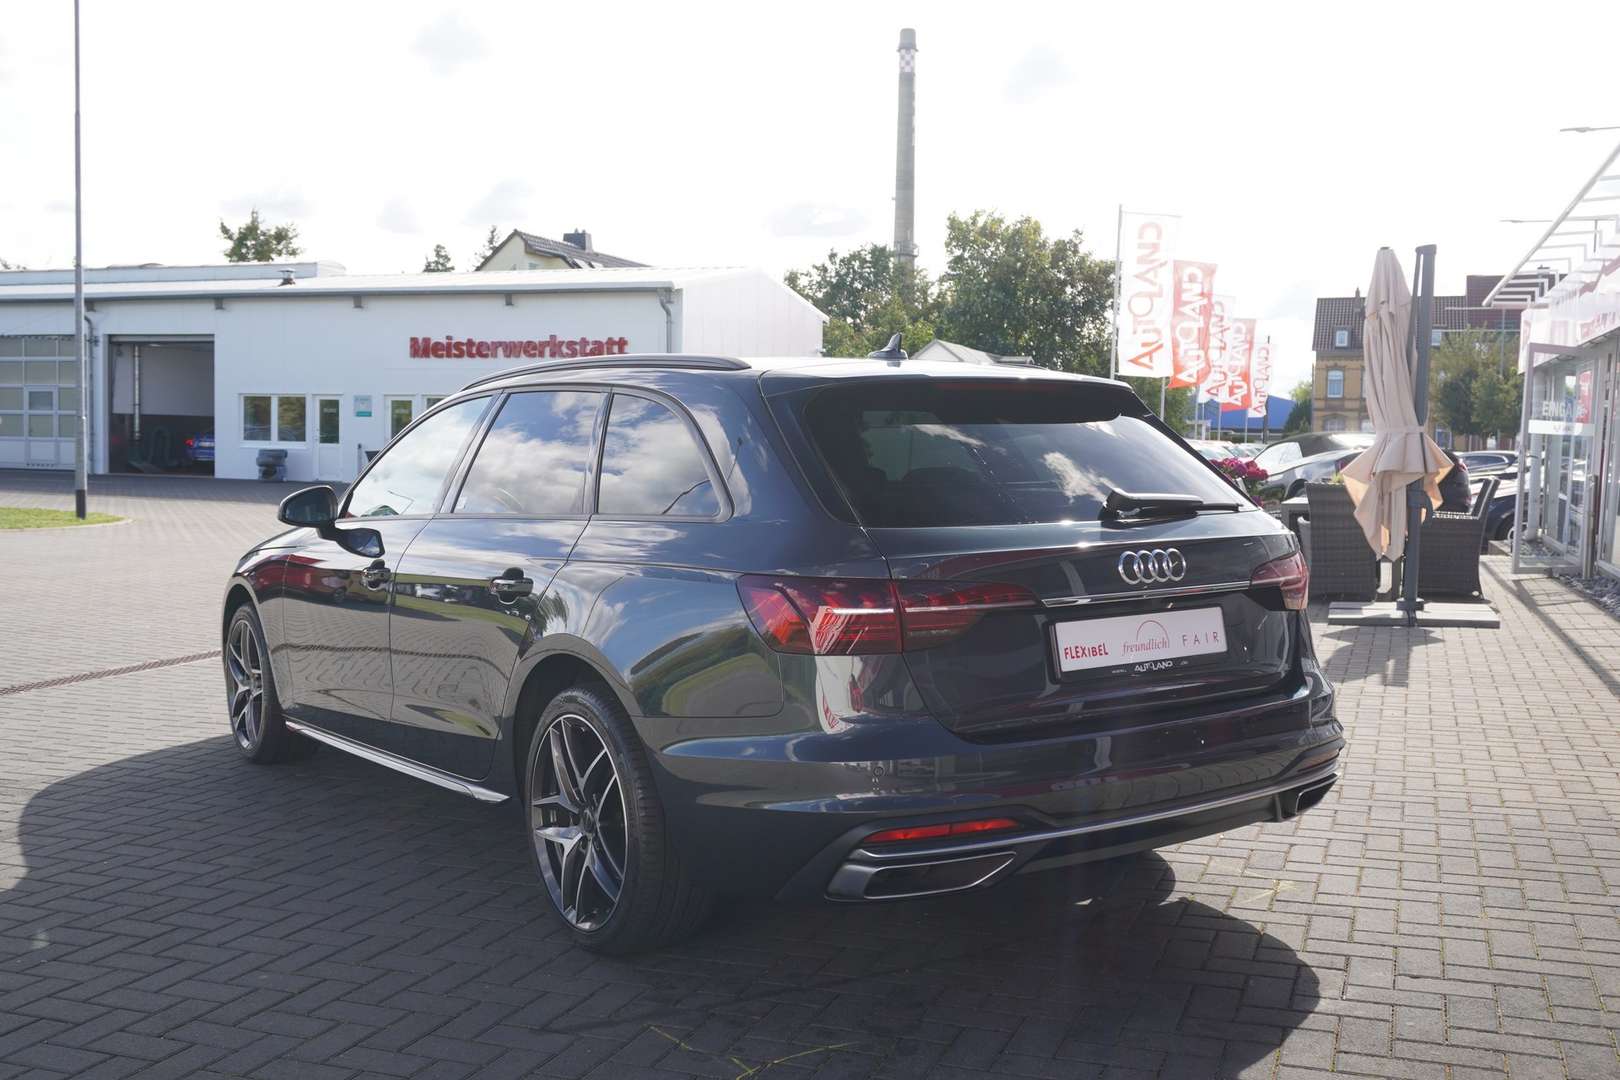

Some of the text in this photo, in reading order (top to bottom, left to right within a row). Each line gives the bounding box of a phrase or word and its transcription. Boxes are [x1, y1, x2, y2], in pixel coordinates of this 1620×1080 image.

[1128, 221, 1168, 371] AUTOLAND
[1176, 266, 1208, 383] AUTOLAND
[409, 335, 629, 359] Meisterwerkstatt
[1064, 631, 1219, 660] FLEXIBEL freundlich FAIR
